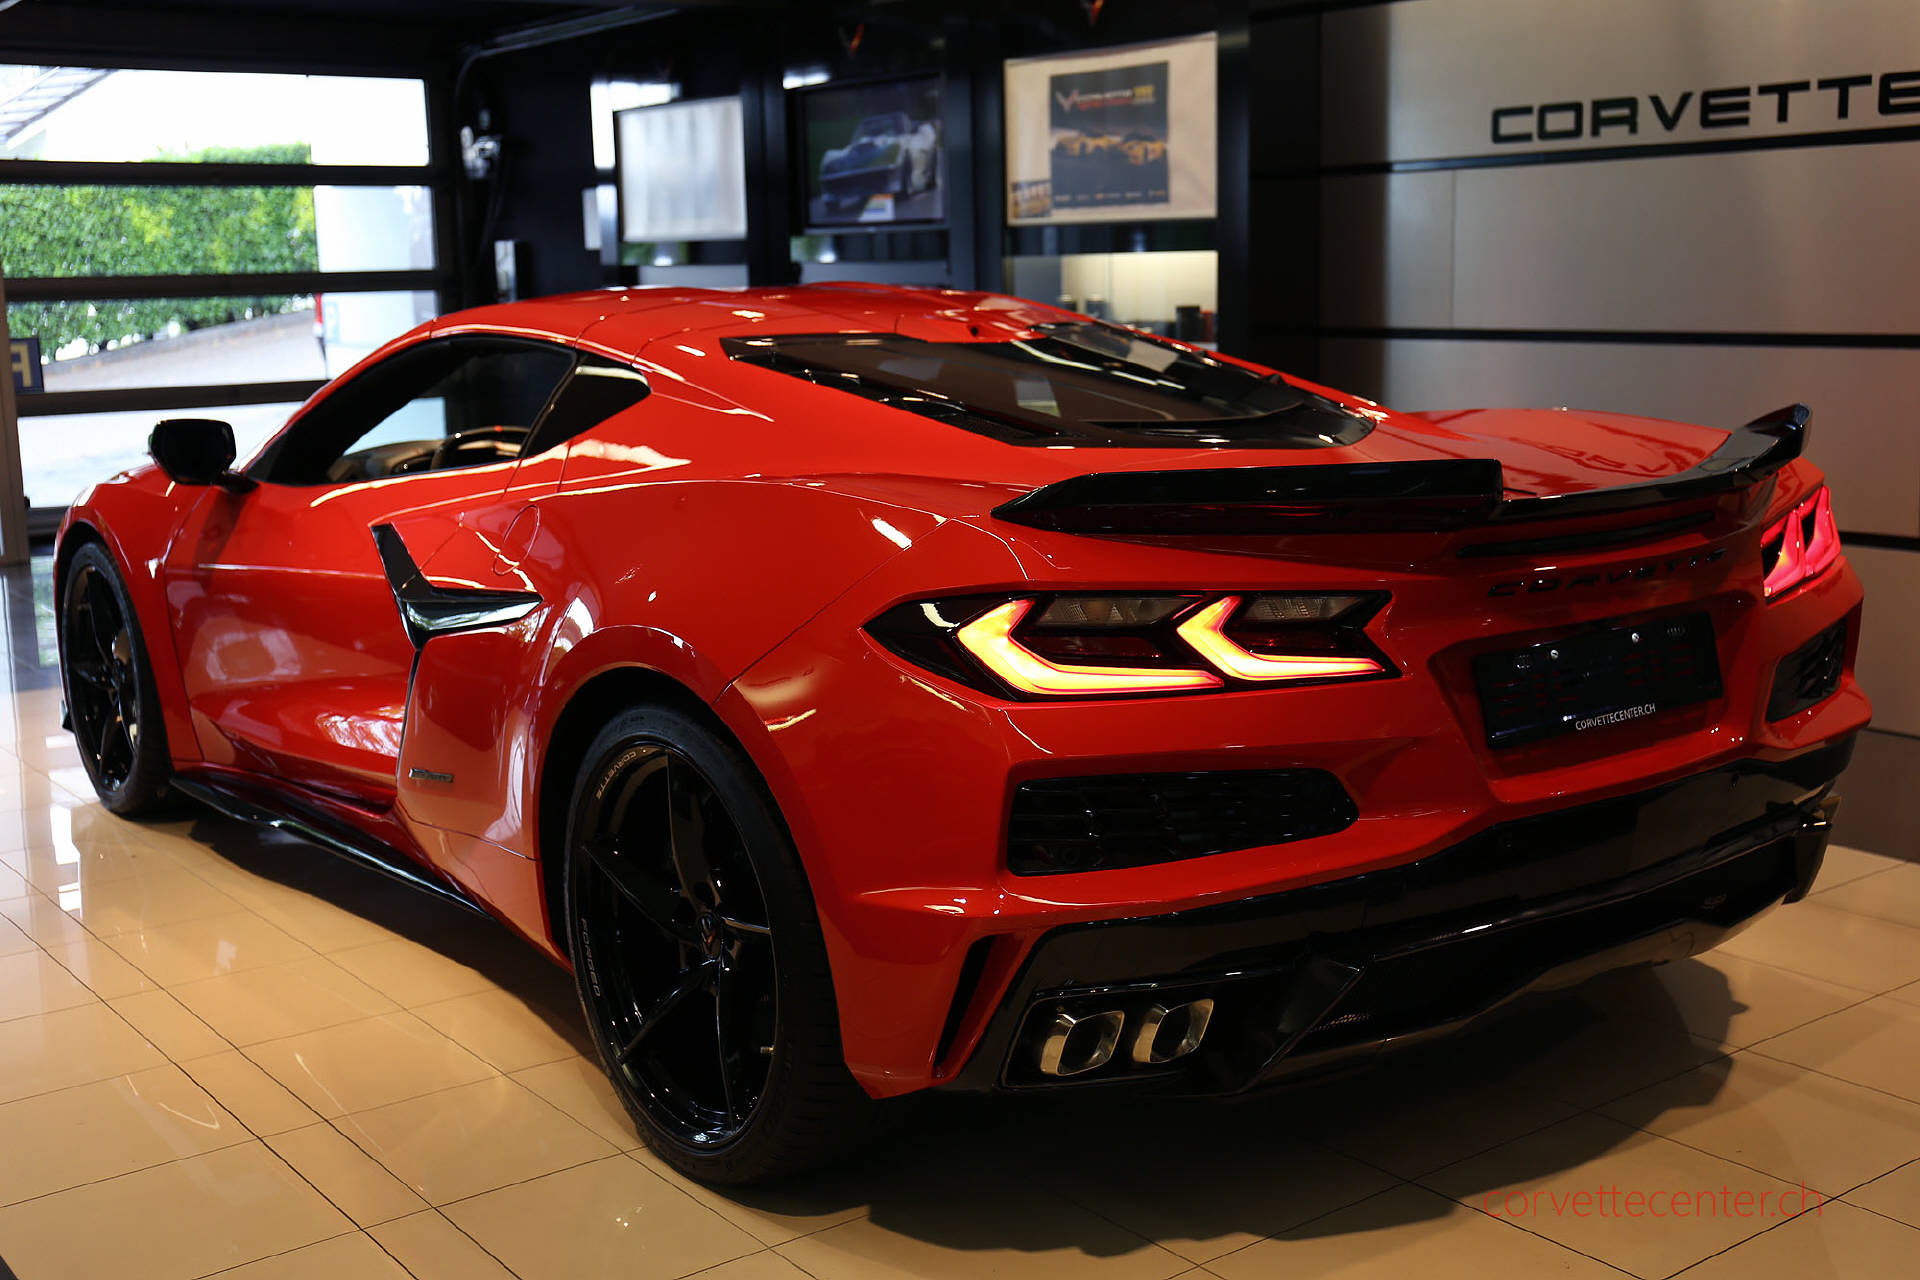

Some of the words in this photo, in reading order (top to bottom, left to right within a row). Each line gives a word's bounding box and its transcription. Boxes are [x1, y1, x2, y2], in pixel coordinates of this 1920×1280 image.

[1491, 70, 1920, 144] CORVETTE
[1488, 549, 1727, 597] CORVETTE
[1575, 703, 1656, 730] CORVETTECENTER.CH
[595, 751, 637, 799] CORVETTE
